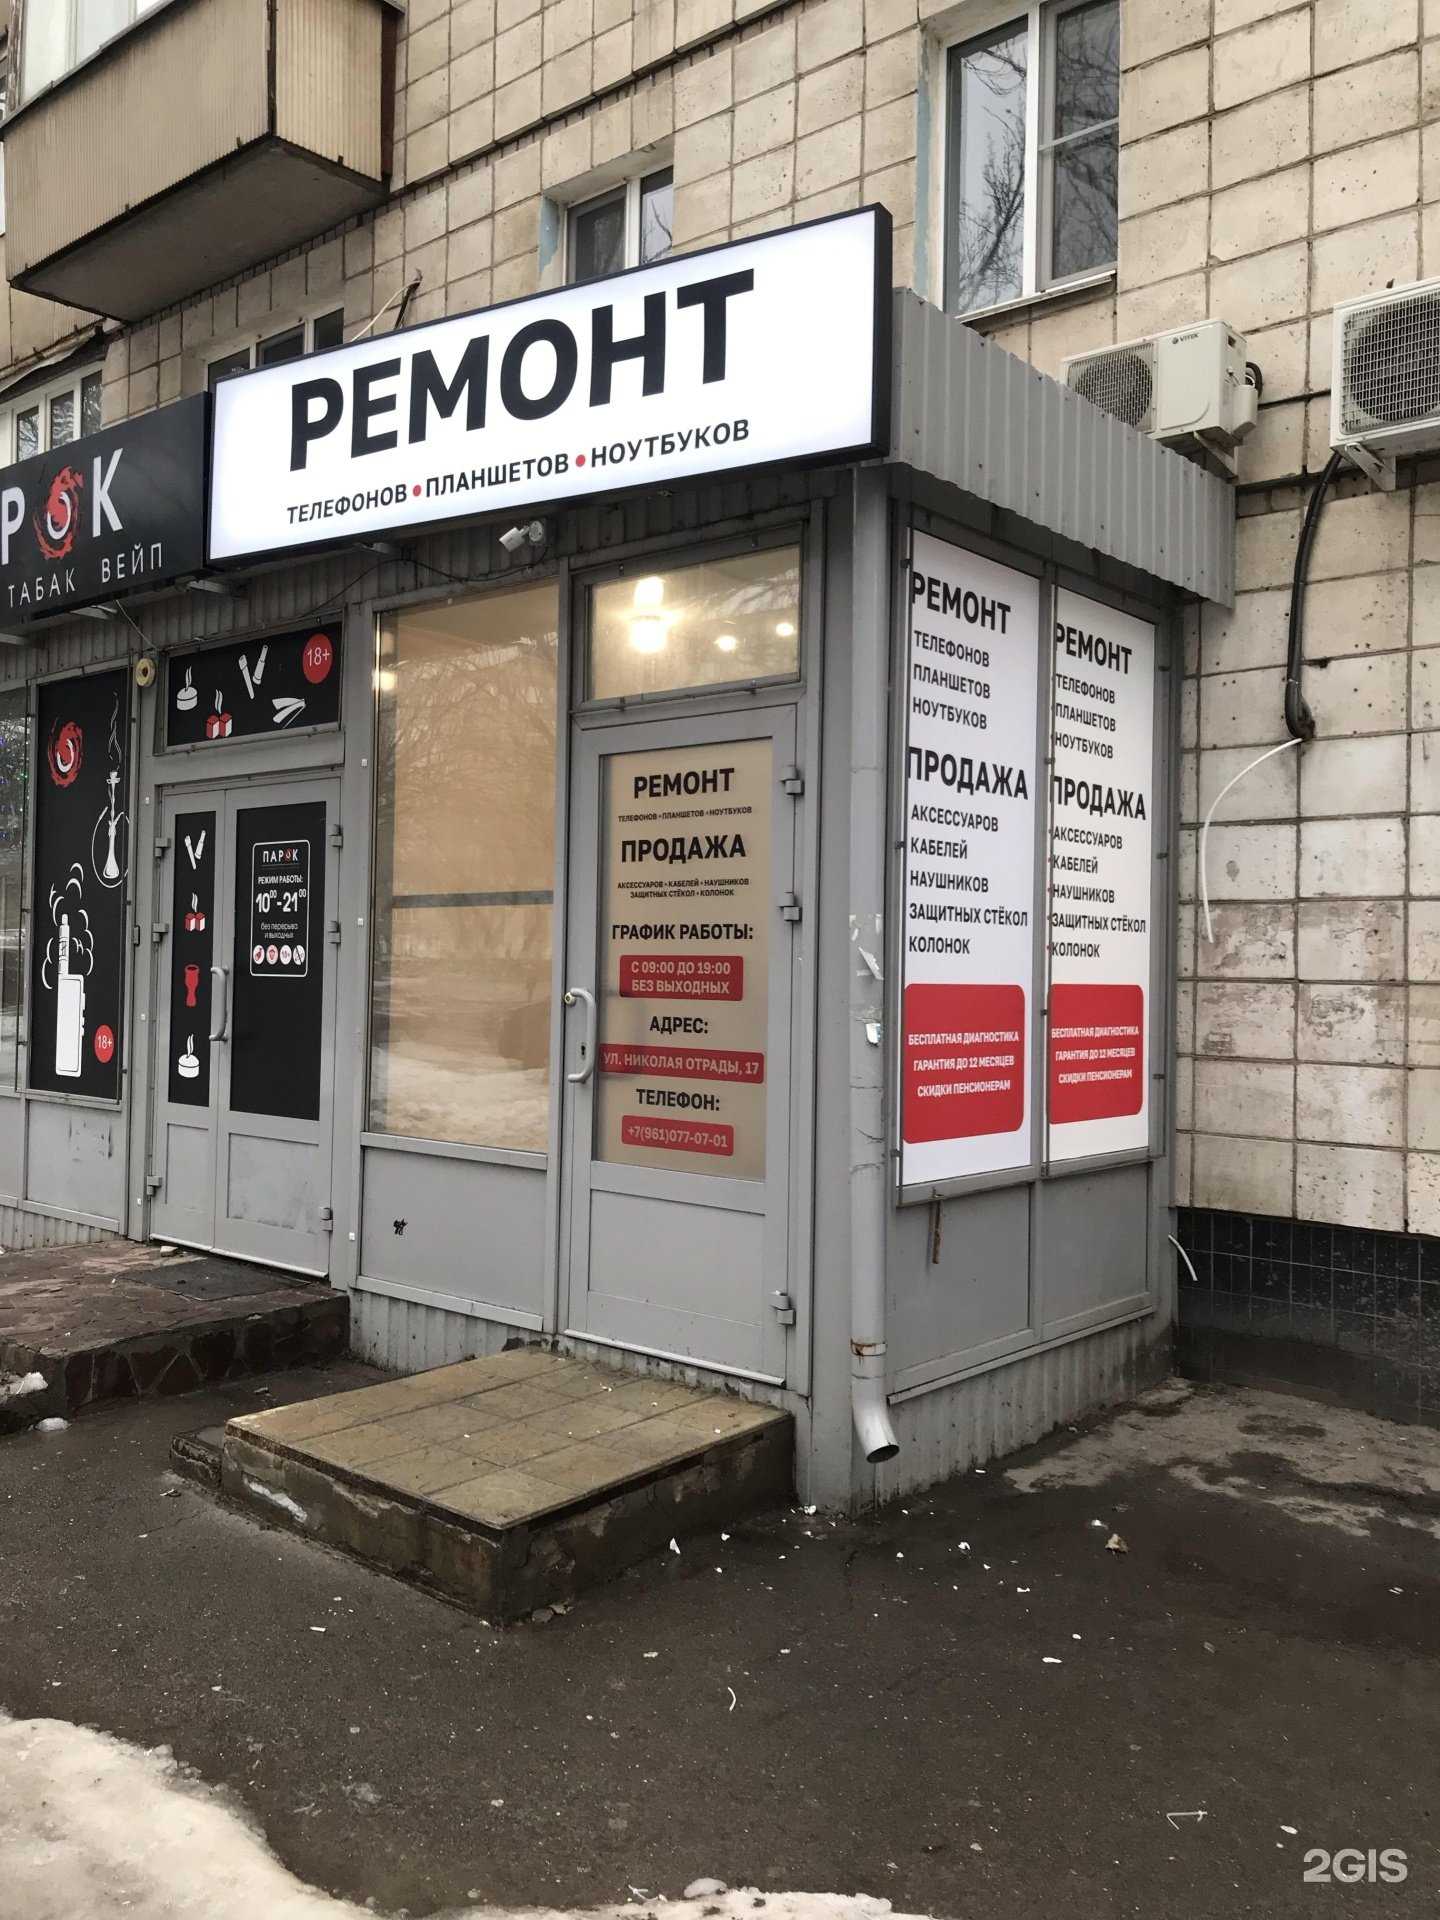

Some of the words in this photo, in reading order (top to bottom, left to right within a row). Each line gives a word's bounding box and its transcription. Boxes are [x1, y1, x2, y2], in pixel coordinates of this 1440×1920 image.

[290, 268, 755, 472] РЕМОНТ
[287, 484, 407, 524] ТЕЛЕФОНОВ
[426, 453, 569, 497] ПЛАНШЕТОВ
[591, 419, 749, 467] НОУТБУКОВ
[8, 567, 76, 608] ТАБАК
[101, 542, 163, 583] ВЕЙП
[911, 571, 1011, 634] РЕМОНТ
[307, 647, 330, 667] 18+
[914, 630, 990, 668] ТЕЛЕФОНОВ
[913, 663, 990, 699] ПЛАНШЕТОВ
[1056, 673, 1115, 704] ТЕЛЕФОНОВ
[912, 697, 987, 730] НОУТБУКОВ
[1055, 703, 1116, 732] ПЛАНШЕТОВ
[1055, 731, 1114, 759] НОУТБУКОВ
[633, 768, 735, 799] РЕМОНТ
[908, 746, 1029, 800] ПРОДАЖА
[618, 812, 658, 823] ТЕЛЕФОНОВ
[662, 809, 704, 820] ПЛАНШЕТОВ
[709, 806, 752, 816] НОУТБУКОВ
[911, 804, 999, 833] АКСЕССУАРОВ
[910, 837, 968, 859] КАБЕЛЕЙ
[1053, 826, 1123, 849] АКСЕССУАРОВ
[621, 834, 746, 864] ПРОДАЖА
[1052, 855, 1098, 874] КАБЕЛЕЙ
[258, 876, 278, 884] РЕЖИМ
[618, 880, 663, 889] АКСЕССУАРОВ
[668, 878, 699, 888] КАБЕЛЕЙ
[704, 877, 749, 887] НАУШНИКОВ
[910, 870, 989, 893] НАУШНИКОВ
[629, 890, 667, 899] ЗАЩИТНЫХ
[668, 888, 695, 898] СТЁКОЛ
[700, 887, 734, 897] КОЛОНОК
[1052, 884, 1115, 904] НАУШНИКОВ
[909, 903, 981, 926] ЗАЩИТНЫХ
[984, 906, 1028, 927] СТЁКОЛ
[1052, 912, 1109, 931] ЗАЩИТНЫХ
[1110, 915, 1146, 933] СТЁКОЛ
[612, 924, 675, 940] ГРАФИК
[680, 924, 753, 940] РАБОТЫ:
[909, 936, 970, 955] КОЛОНОК
[1052, 941, 1100, 957] КОЛОНОК
[631, 962, 639, 973] С
[641, 962, 674, 974] 09:00
[677, 962, 694, 976] ДО
[697, 962, 731, 975] 19:00
[631, 980, 654, 992] БЕЗ
[656, 980, 729, 995] ВЫХОДНЫХ
[650, 1016, 708, 1034] АДРЕС:
[1051, 1027, 1094, 1039] БЕСПЛАТНАЯ
[1094, 1026, 1139, 1037] ДИАГНОСТИКА
[98, 1034, 112, 1049] 18+
[908, 1033, 962, 1045] БЕСПЛАТНАЯ
[963, 1031, 1019, 1044] ДИАГНОСТИКА
[604, 1052, 622, 1066] УЛ.
[624, 1054, 683, 1070] НИКОЛАЯ
[686, 1058, 742, 1076] ОТРАДЫ,
[746, 1062, 759, 1076] 17
[913, 1058, 955, 1072] ГАРАНТИЯ
[956, 1058, 968, 1071] ДО
[969, 1057, 978, 1068] 12
[979, 1055, 1015, 1068] МЕСЯЦЕВ
[1055, 1050, 1088, 1061] ГАРАНТИЯ
[1089, 1049, 1099, 1061] ДО
[1107, 1047, 1135, 1058] МЕСЯЦЕВ
[1059, 1072, 1086, 1084] СКИДКИ
[1087, 1069, 1132, 1082] ПЕНСИОНЕРАМ
[636, 1088, 720, 1111] ТЕЛЕФОН:
[918, 1084, 952, 1098] СКИДКИ
[953, 1080, 1011, 1095] ПЕНСИОНЕРАМ
[628, 1126, 728, 1148] +7(961)077-07-01
